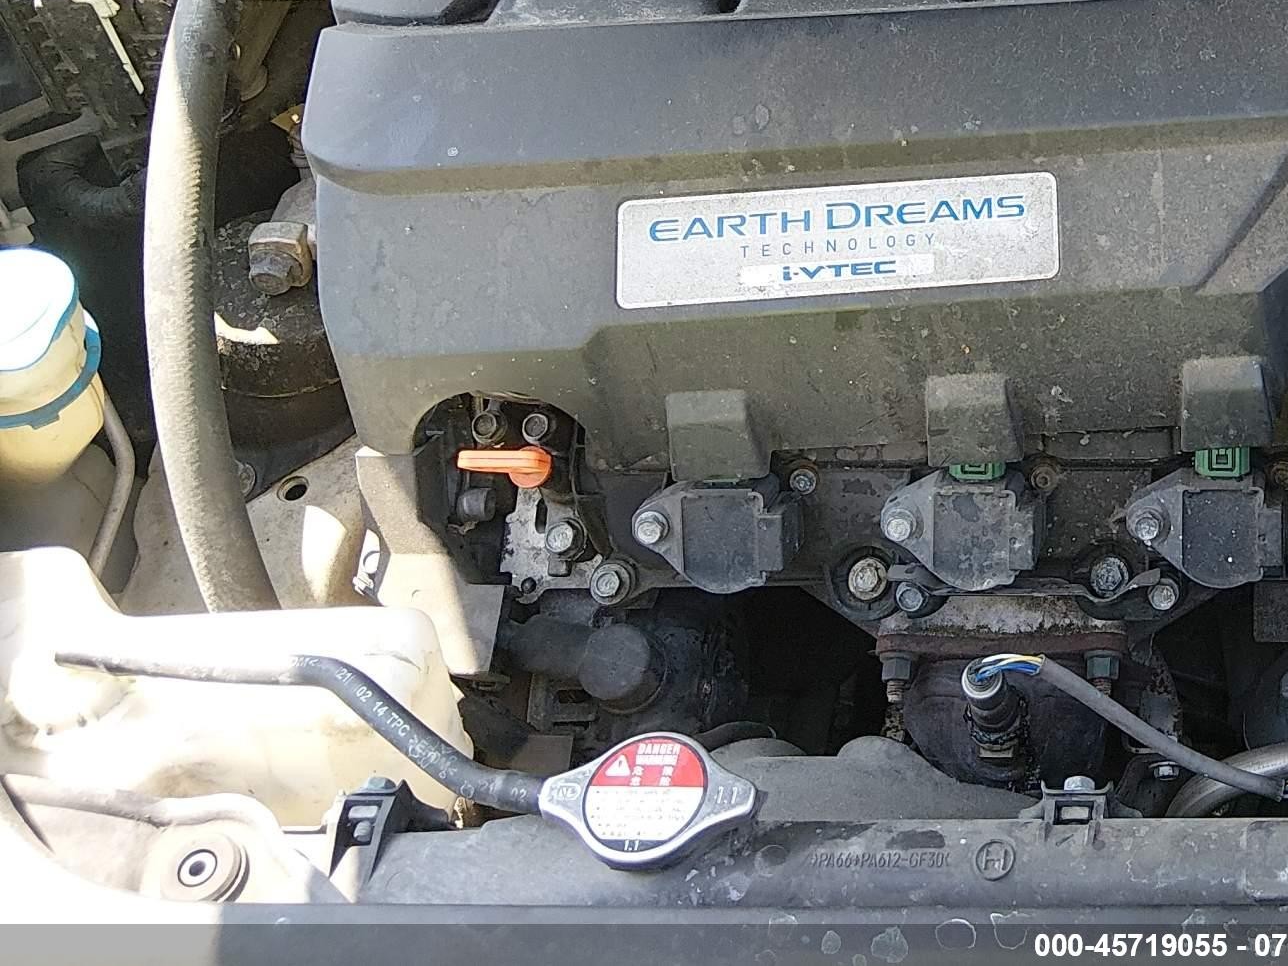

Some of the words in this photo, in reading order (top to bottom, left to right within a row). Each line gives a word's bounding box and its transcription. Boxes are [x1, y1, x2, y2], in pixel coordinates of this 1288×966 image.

[649, 209, 810, 244] EARTH
[826, 194, 1026, 231] DREAMS
[739, 232, 937, 259] TECHNOLOGY
[782, 259, 898, 282] i-VTEC
[372, 700, 386, 718] 14
[386, 711, 410, 737] TPC
[637, 742, 681, 755] DANGER
[623, 839, 640, 852] 1.1
